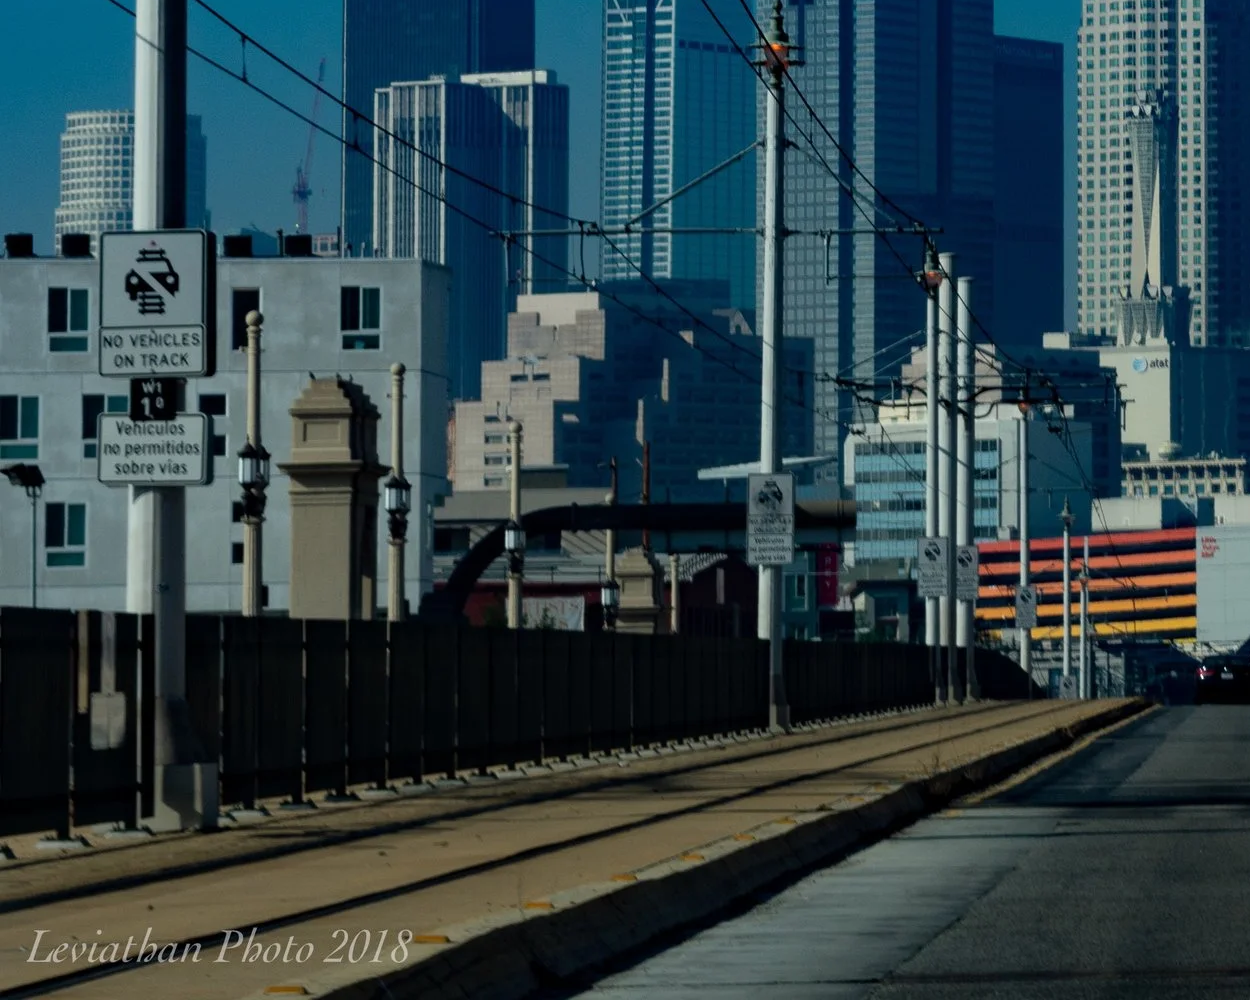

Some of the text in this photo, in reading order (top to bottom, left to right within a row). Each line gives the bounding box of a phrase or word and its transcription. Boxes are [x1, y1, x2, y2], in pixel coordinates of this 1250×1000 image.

[103, 333, 200, 348] NO VEHICLES
[114, 353, 189, 368] ON TRACK
[104, 442, 200, 457] no permitidos
[114, 460, 155, 474] sobre
